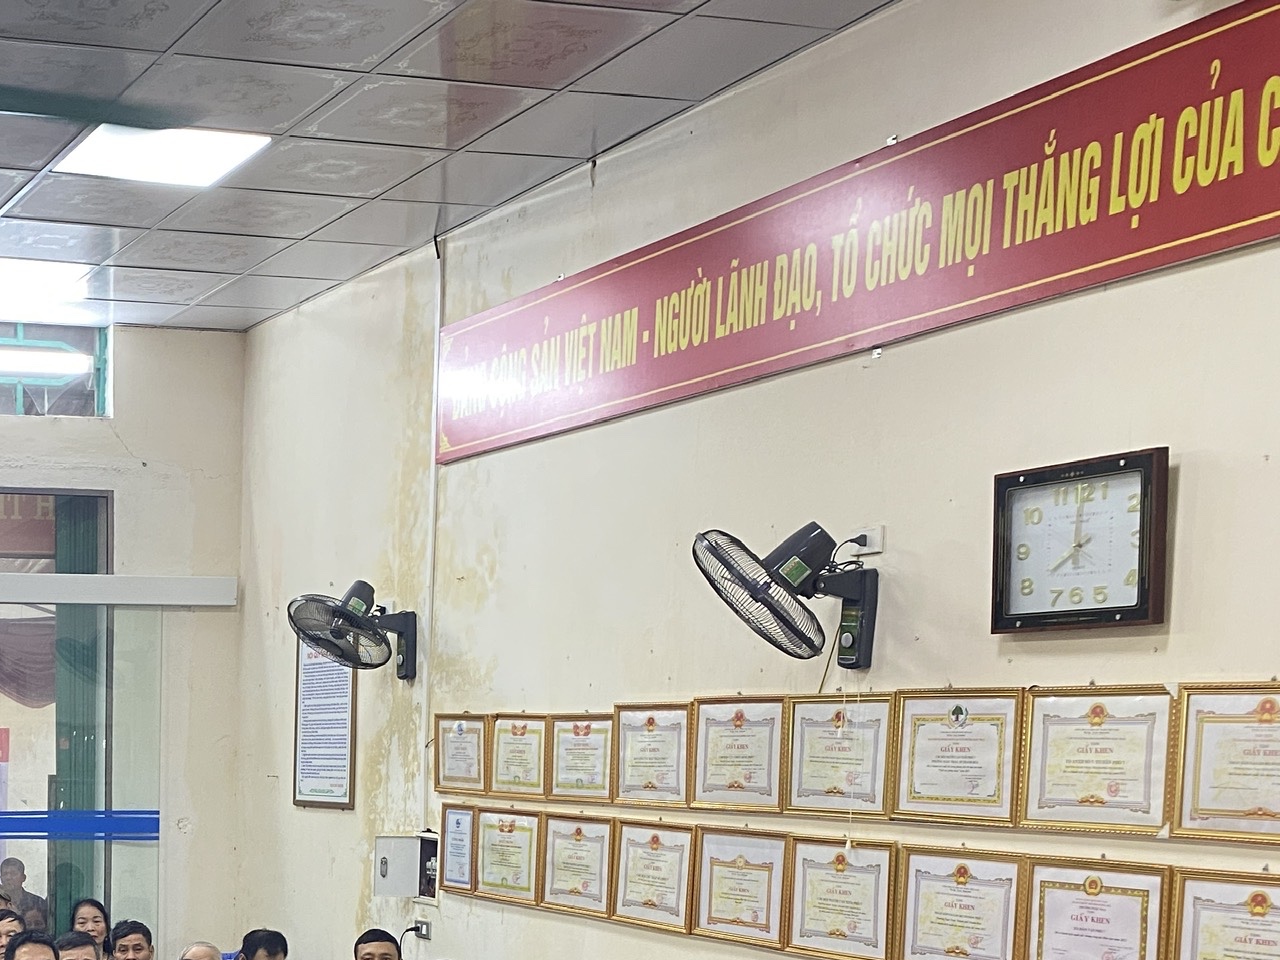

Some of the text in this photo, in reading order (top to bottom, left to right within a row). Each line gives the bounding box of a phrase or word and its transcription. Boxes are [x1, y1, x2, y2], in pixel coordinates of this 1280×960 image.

[530, 315, 560, 400] SẢN
[564, 313, 597, 395] VIỆT
[599, 306, 638, 374] NAM
[642, 330, 650, 343] -
[653, 267, 711, 358] NGƯỜI
[715, 258, 768, 339] LÃNH
[772, 242, 822, 330] ĐẠO,
[831, 197, 862, 302] TỔ
[865, 185, 933, 291] CHỨC
[938, 178, 995, 277] MỌI
[1002, 129, 1102, 249] THẮNG
[1108, 113, 1165, 229] LỢI
[1172, 58, 1245, 195] CỦA
[1051, 486, 1068, 506] 11
[1074, 482, 1095, 504] 12
[1101, 481, 1109, 499] 1
[1127, 494, 1140, 513] 2
[1023, 506, 1043, 525] 10
[1017, 543, 1030, 560] 9
[1020, 578, 1034, 596] 8
[1124, 569, 1137, 587] 4
[1049, 589, 1063, 607] 7
[1070, 587, 1084, 604] 6
[1093, 586, 1108, 603] 5
